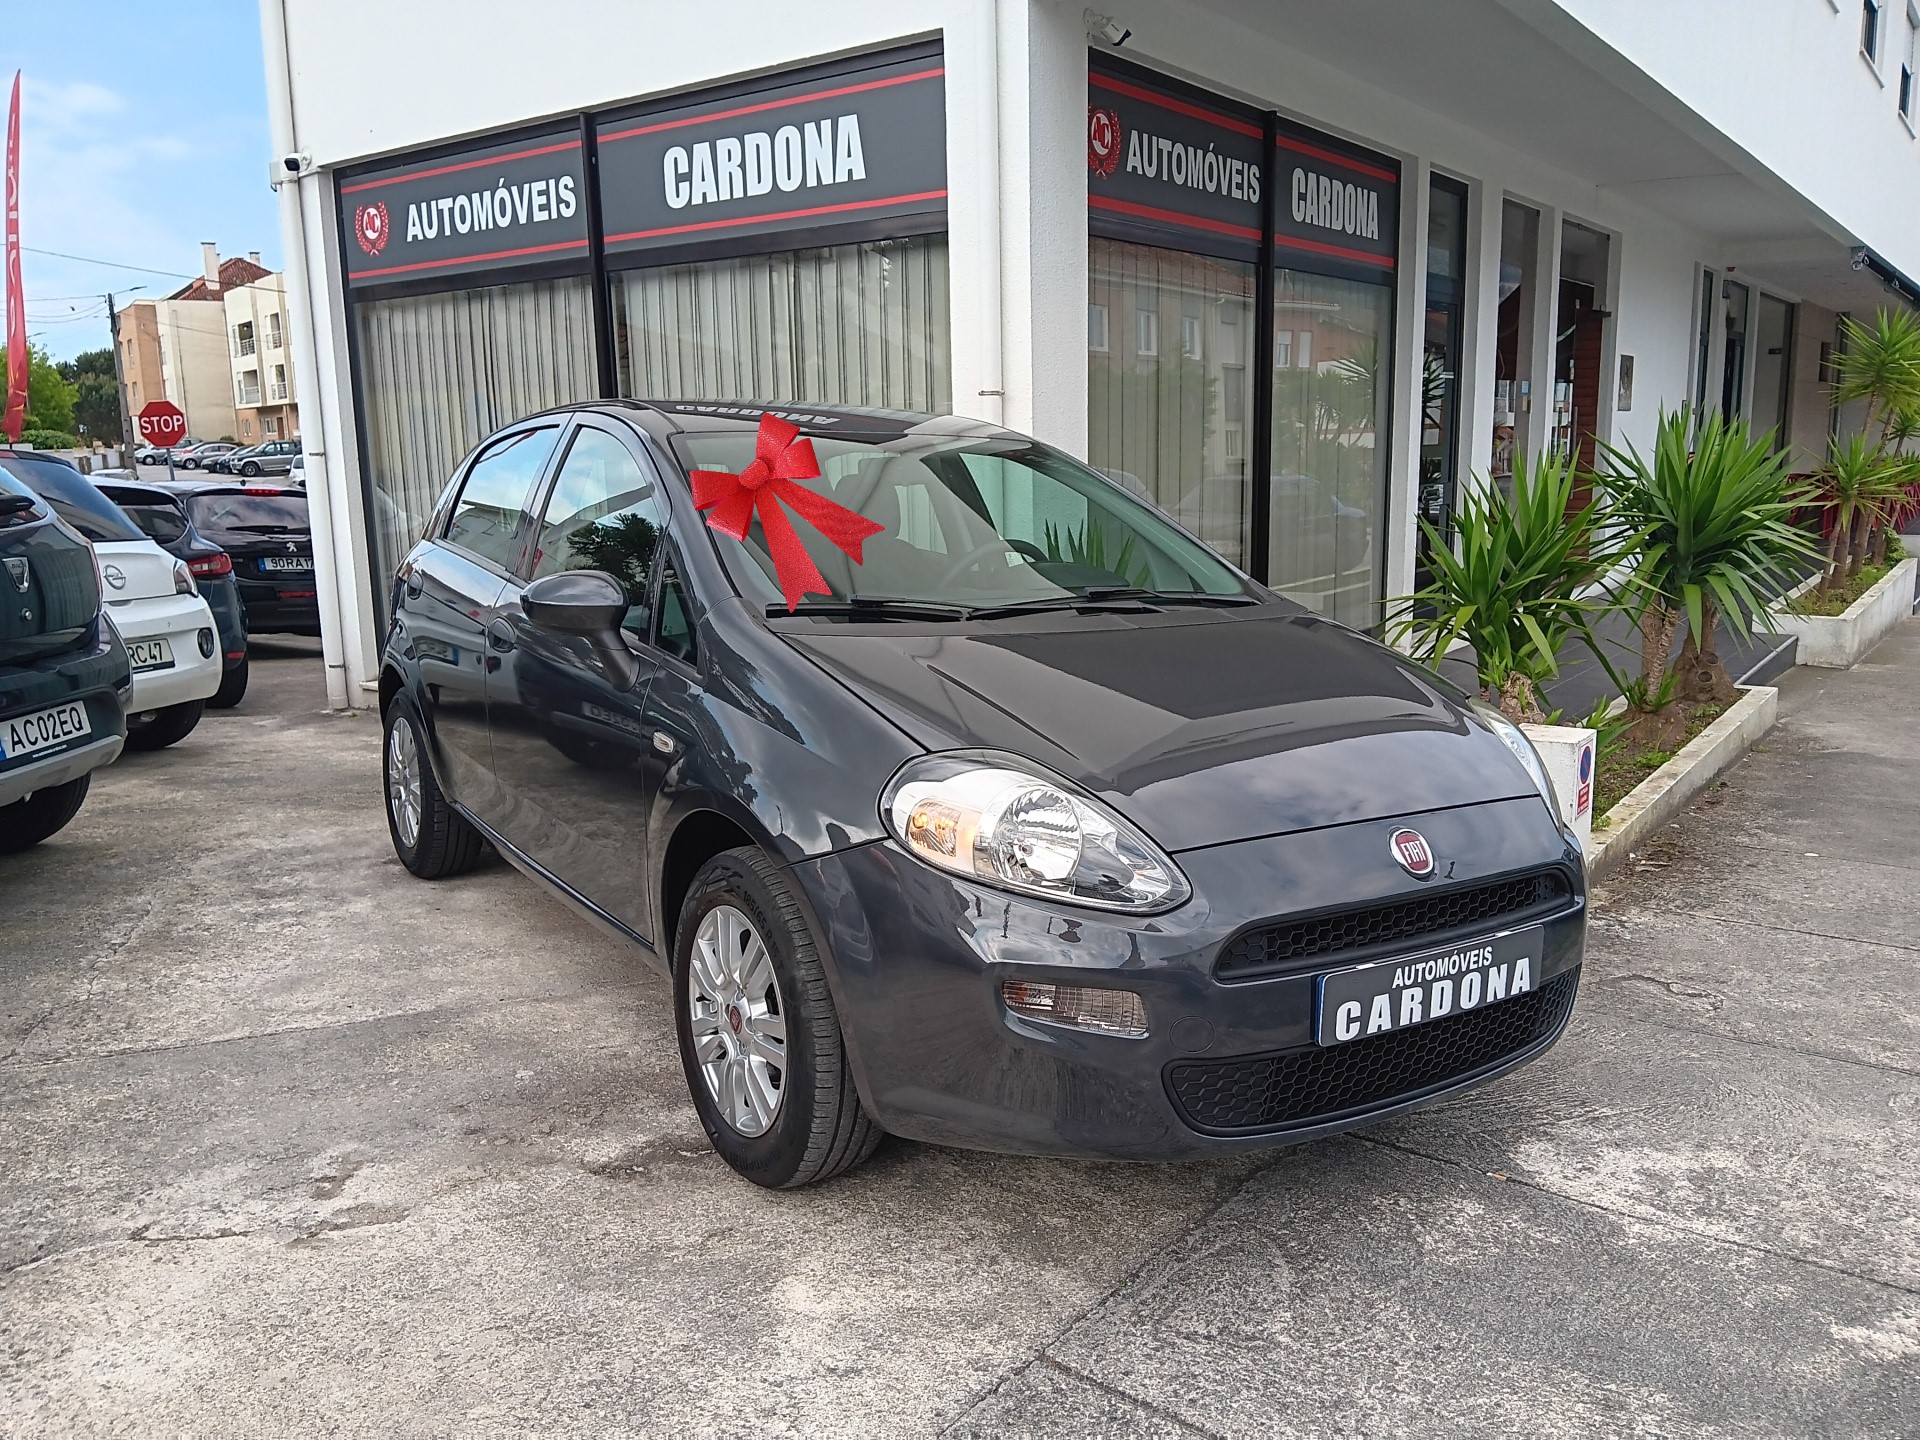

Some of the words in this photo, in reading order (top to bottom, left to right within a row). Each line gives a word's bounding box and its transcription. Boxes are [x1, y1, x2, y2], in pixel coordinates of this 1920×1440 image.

[663, 113, 866, 209] CARDONA
[1126, 129, 1260, 204] AUTOMÓVEIS
[406, 175, 577, 242] AUTOMÓVEIS
[1292, 167, 1379, 240] CARDONA
[140, 414, 183, 434] STOP
[10, 706, 84, 753] AC02EQ
[1399, 840, 1426, 864] FIAT
[1335, 957, 1531, 1041] CARDONA
[1392, 946, 1493, 989] AUTOMÓVEIS
